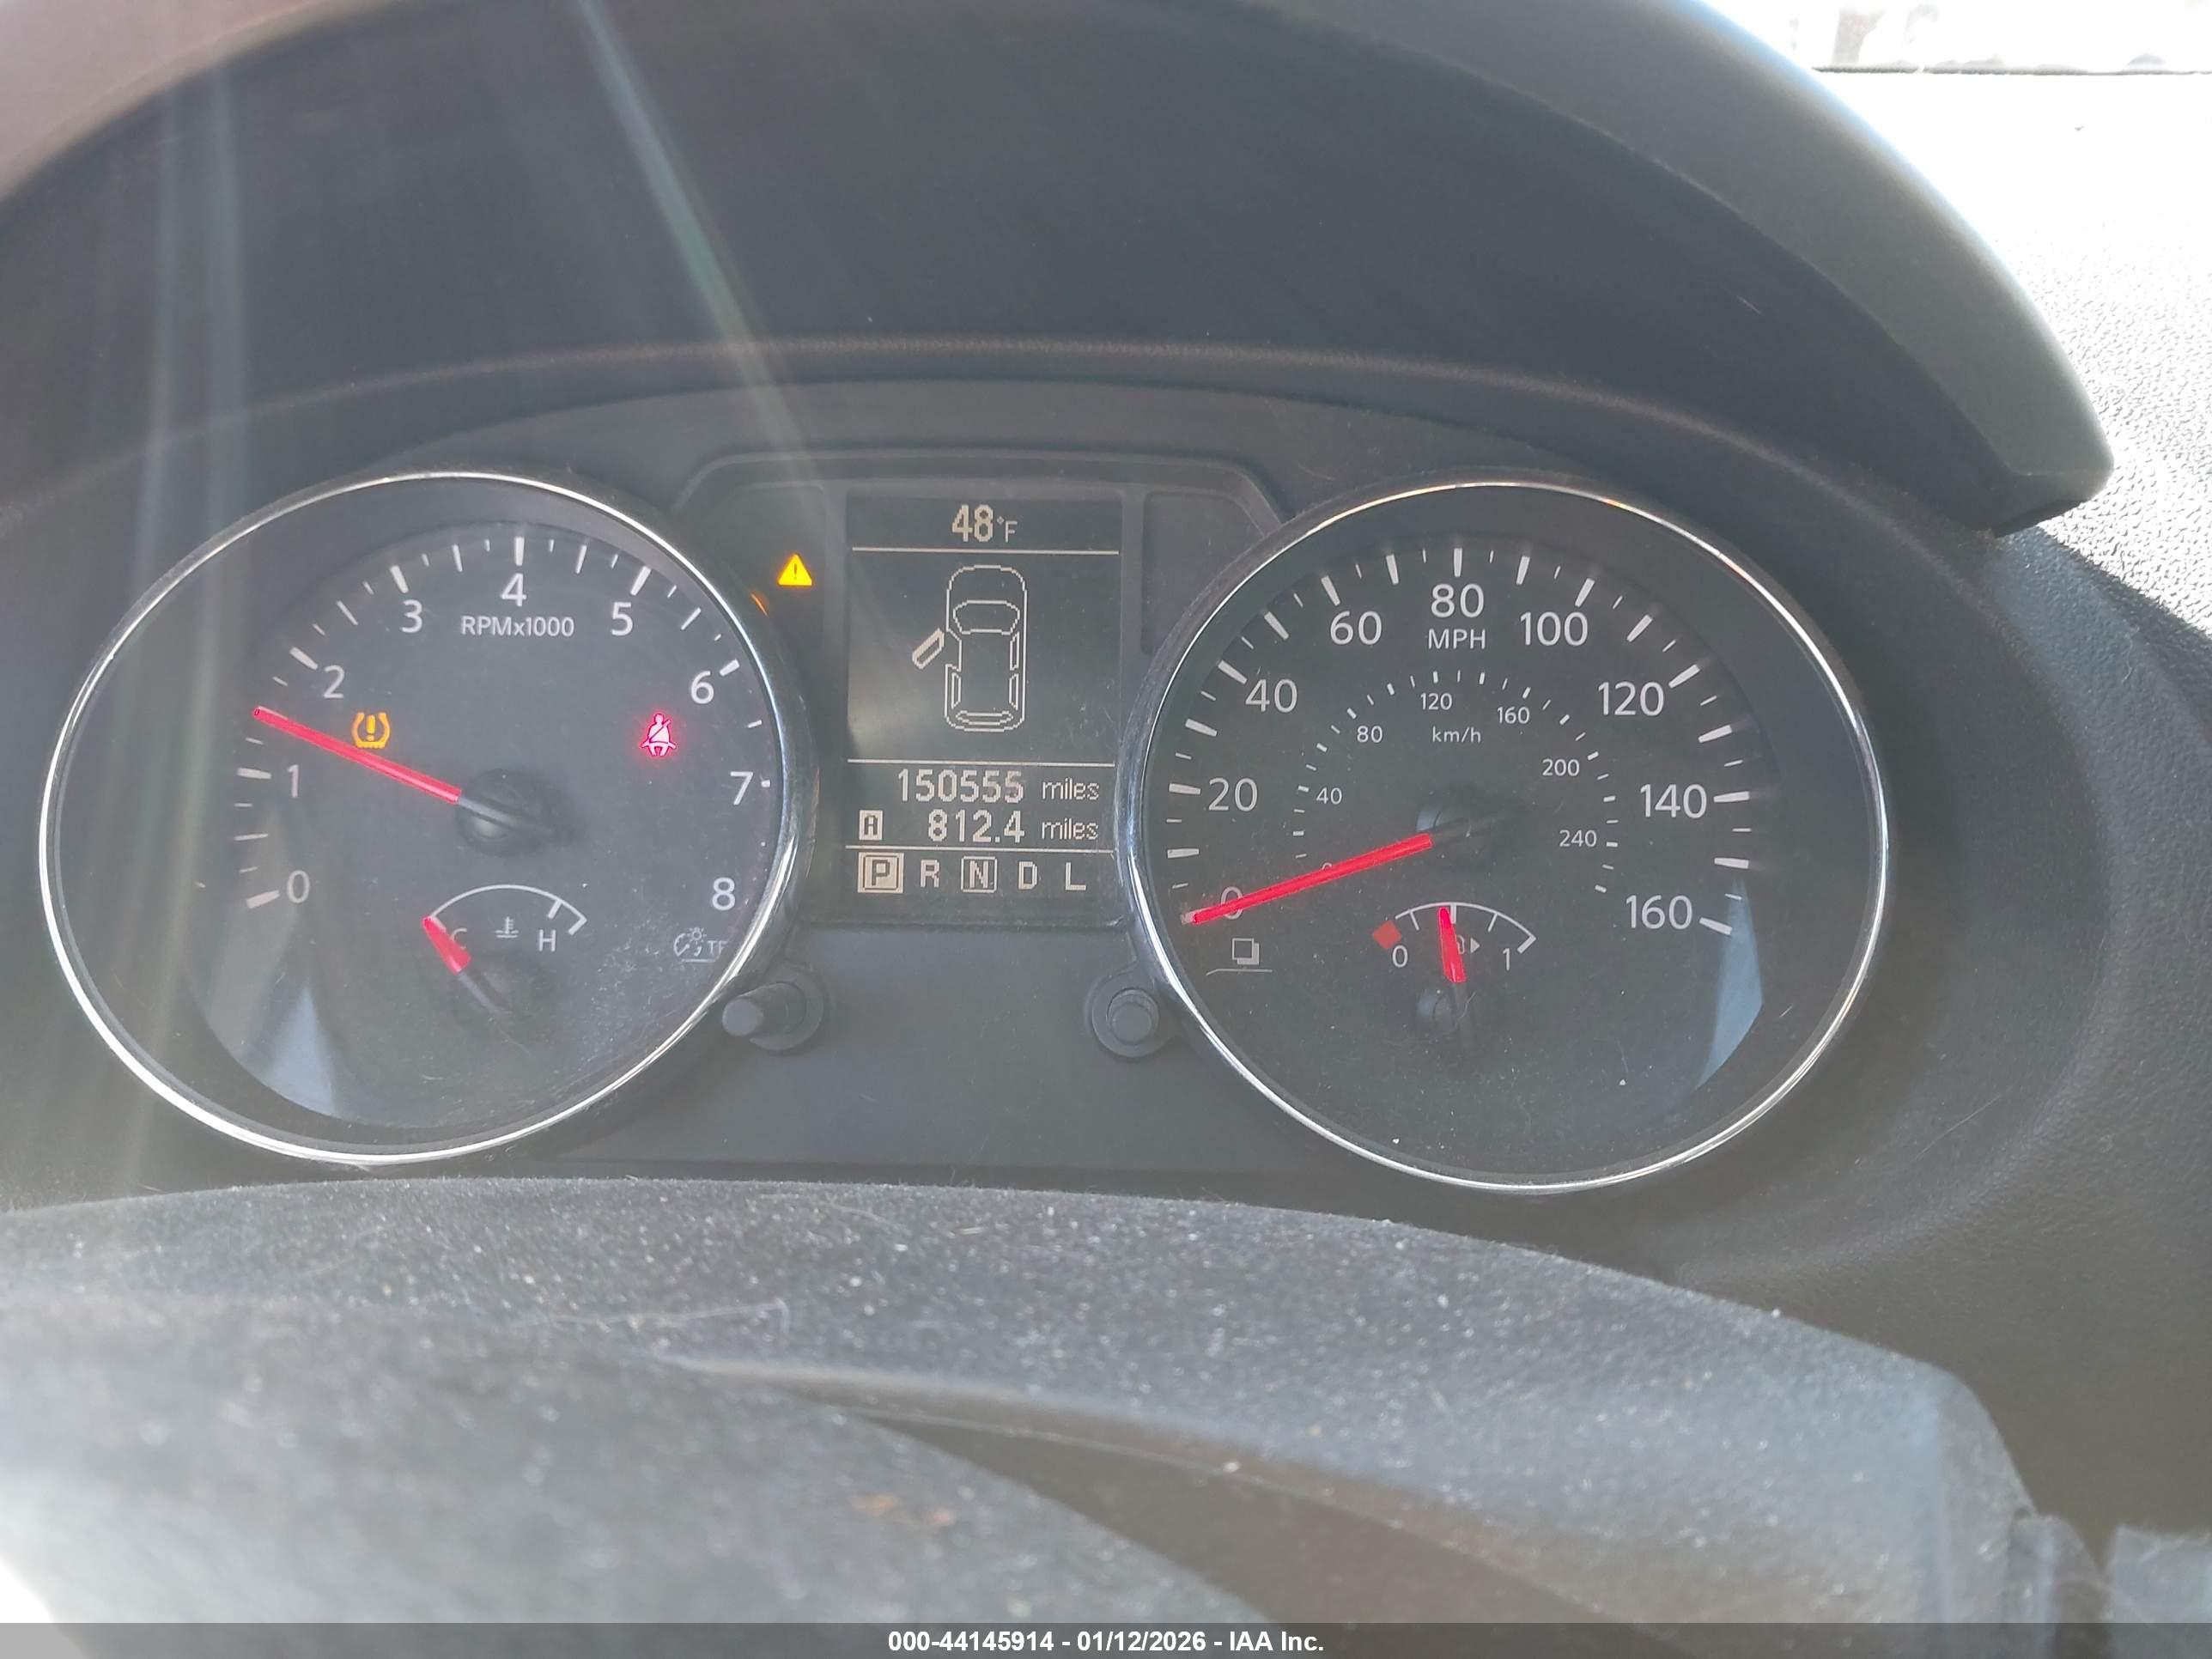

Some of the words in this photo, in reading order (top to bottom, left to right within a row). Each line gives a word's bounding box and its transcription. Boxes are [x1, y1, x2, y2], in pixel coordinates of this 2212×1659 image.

[501, 574, 526, 606] 4
[1431, 584, 1485, 618] 80
[401, 599, 423, 633] 3
[461, 617, 575, 637] RPMx1000
[611, 602, 634, 635] 5
[1329, 611, 1382, 645] 60
[1520, 612, 1589, 646] 100
[1427, 629, 1486, 649] MPH
[323, 665, 344, 699] 2
[690, 672, 714, 703] 6
[1245, 679, 1297, 712] 40
[1420, 692, 1453, 711] 120
[1599, 682, 1664, 716] 120
[1497, 707, 1531, 726] 160
[1356, 726, 1383, 744] 80
[1431, 727, 1482, 744] km/h
[289, 764, 301, 797] 1
[1542, 758, 1580, 776] 200
[731, 771, 755, 805] 7
[898, 769, 1024, 803] 150555
[1042, 777, 1101, 800] miles
[1208, 779, 1258, 811] 20
[1316, 787, 1342, 805] 40
[1639, 785, 1707, 818] 140
[927, 809, 1025, 843] 812.4
[1041, 817, 1099, 841] miles
[1559, 829, 1597, 848] 240
[286, 870, 310, 903] 0
[920, 859, 940, 888] R
[969, 860, 989, 889] N
[1018, 860, 1038, 890] D
[1065, 861, 1087, 891] L
[711, 878, 736, 910] 8
[1220, 886, 1243, 920] 0
[1626, 896, 1692, 929] 160
[538, 929, 556, 952] H
[1392, 945, 1408, 968] 0
[1502, 947, 1510, 971] 1
